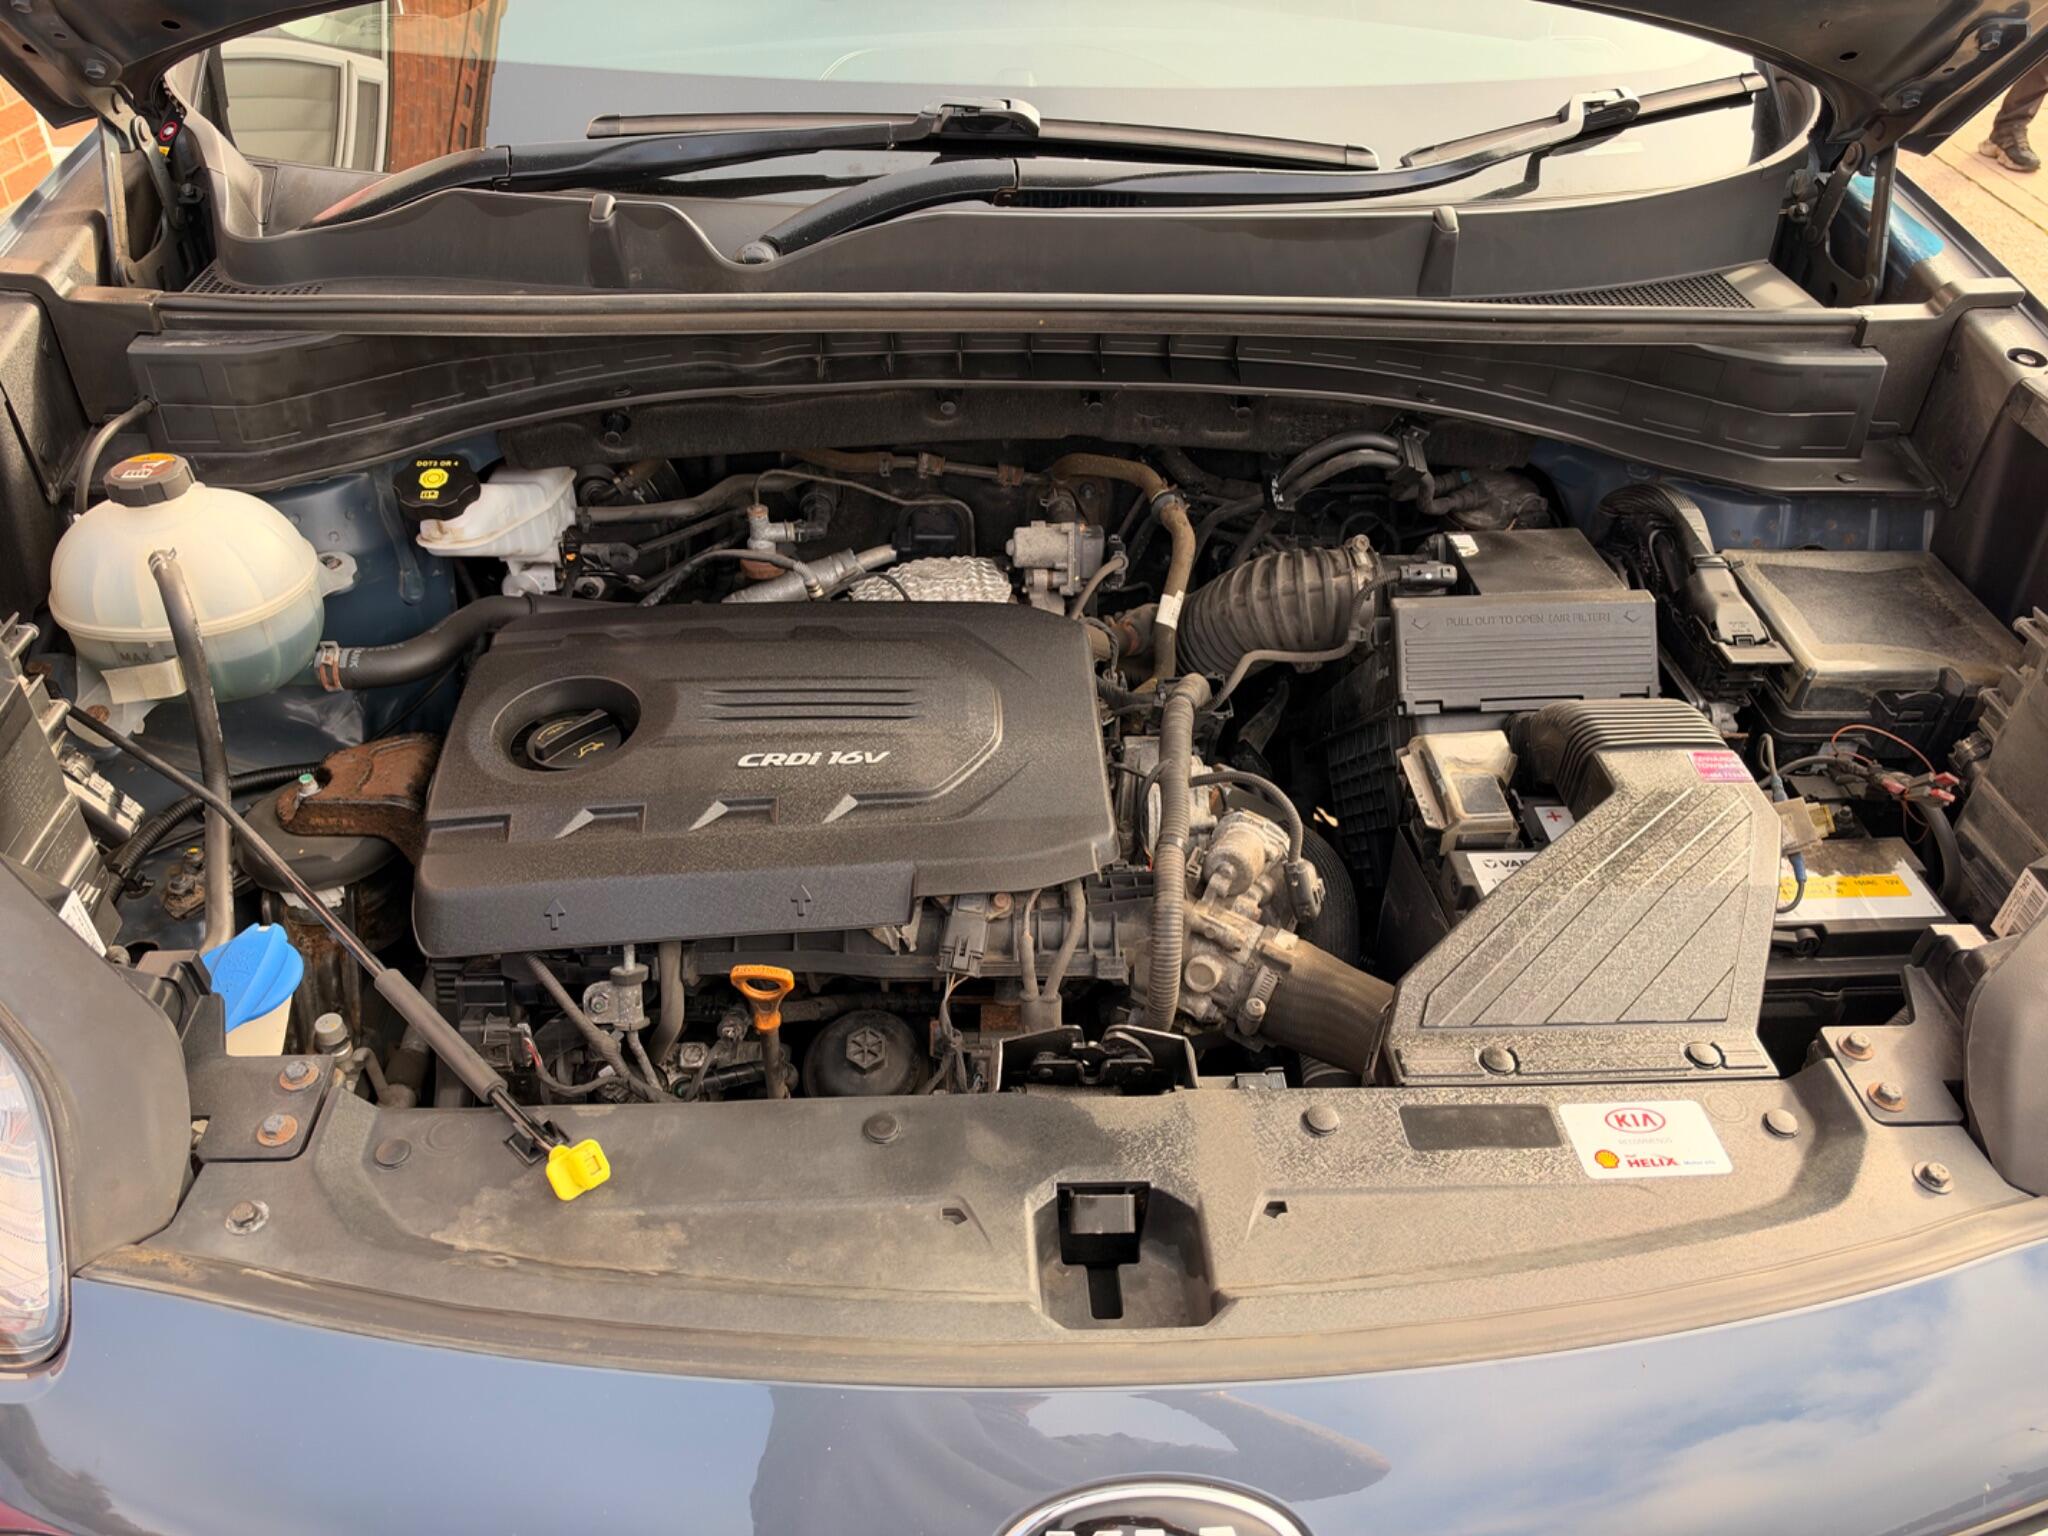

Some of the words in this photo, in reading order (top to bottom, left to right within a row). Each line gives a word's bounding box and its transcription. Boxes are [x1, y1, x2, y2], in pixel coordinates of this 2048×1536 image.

[1445, 615, 1474, 627] PULL
[1475, 615, 1496, 626] OUT
[1498, 614, 1514, 625] TO
[1515, 613, 1544, 625] OPEN
[119, 652, 152, 661] MAX
[827, 750, 891, 765] 16V
[1614, 1113, 1658, 1128] KIA
[1626, 1157, 1681, 1168] HELIX
